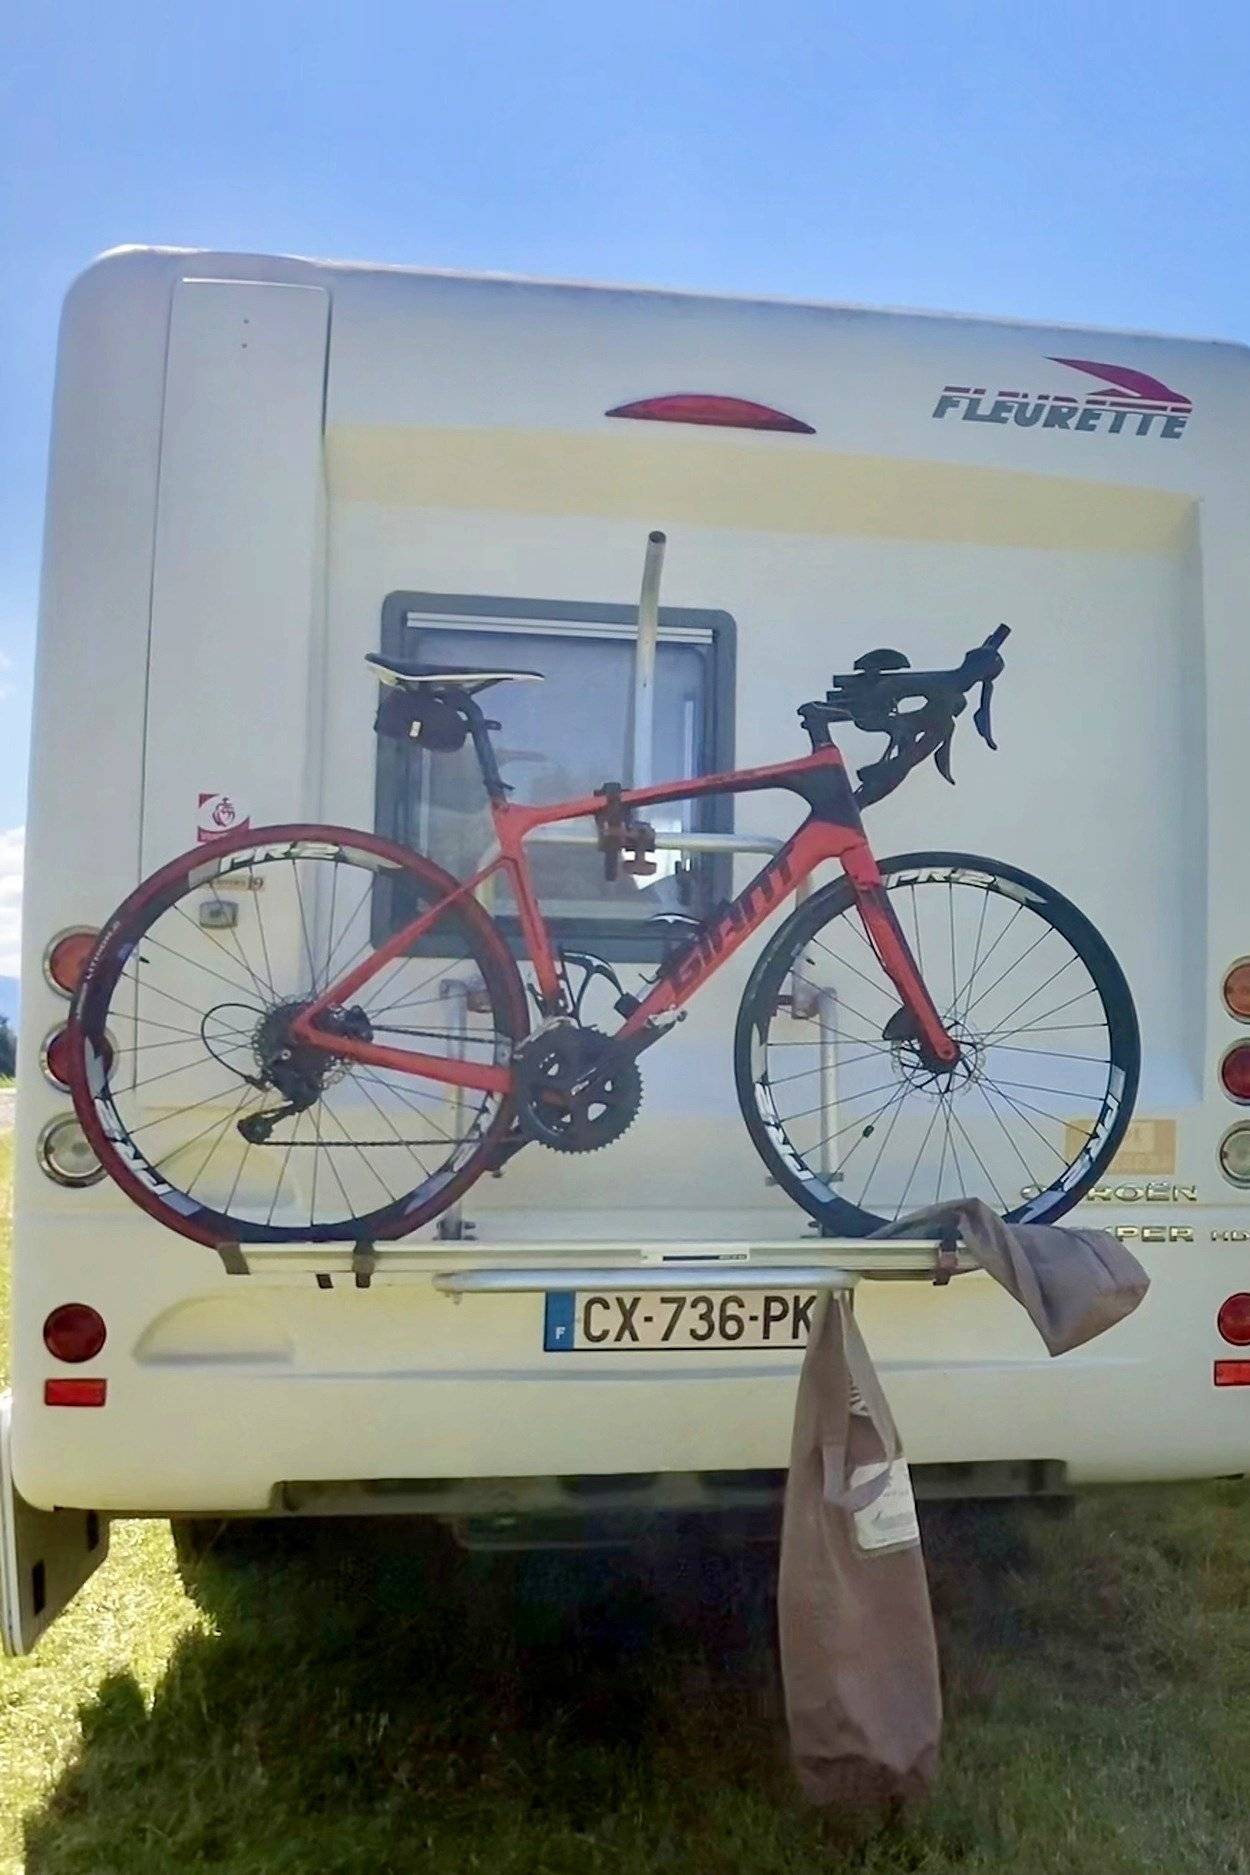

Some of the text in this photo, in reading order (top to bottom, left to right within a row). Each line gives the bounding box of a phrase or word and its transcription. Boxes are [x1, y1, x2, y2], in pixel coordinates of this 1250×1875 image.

[932, 386, 1193, 439] FLEURETTE
[1020, 1182, 1198, 1202] CROËN
[555, 1326, 566, 1340] F
[583, 1295, 817, 1343] CX-736-PK
